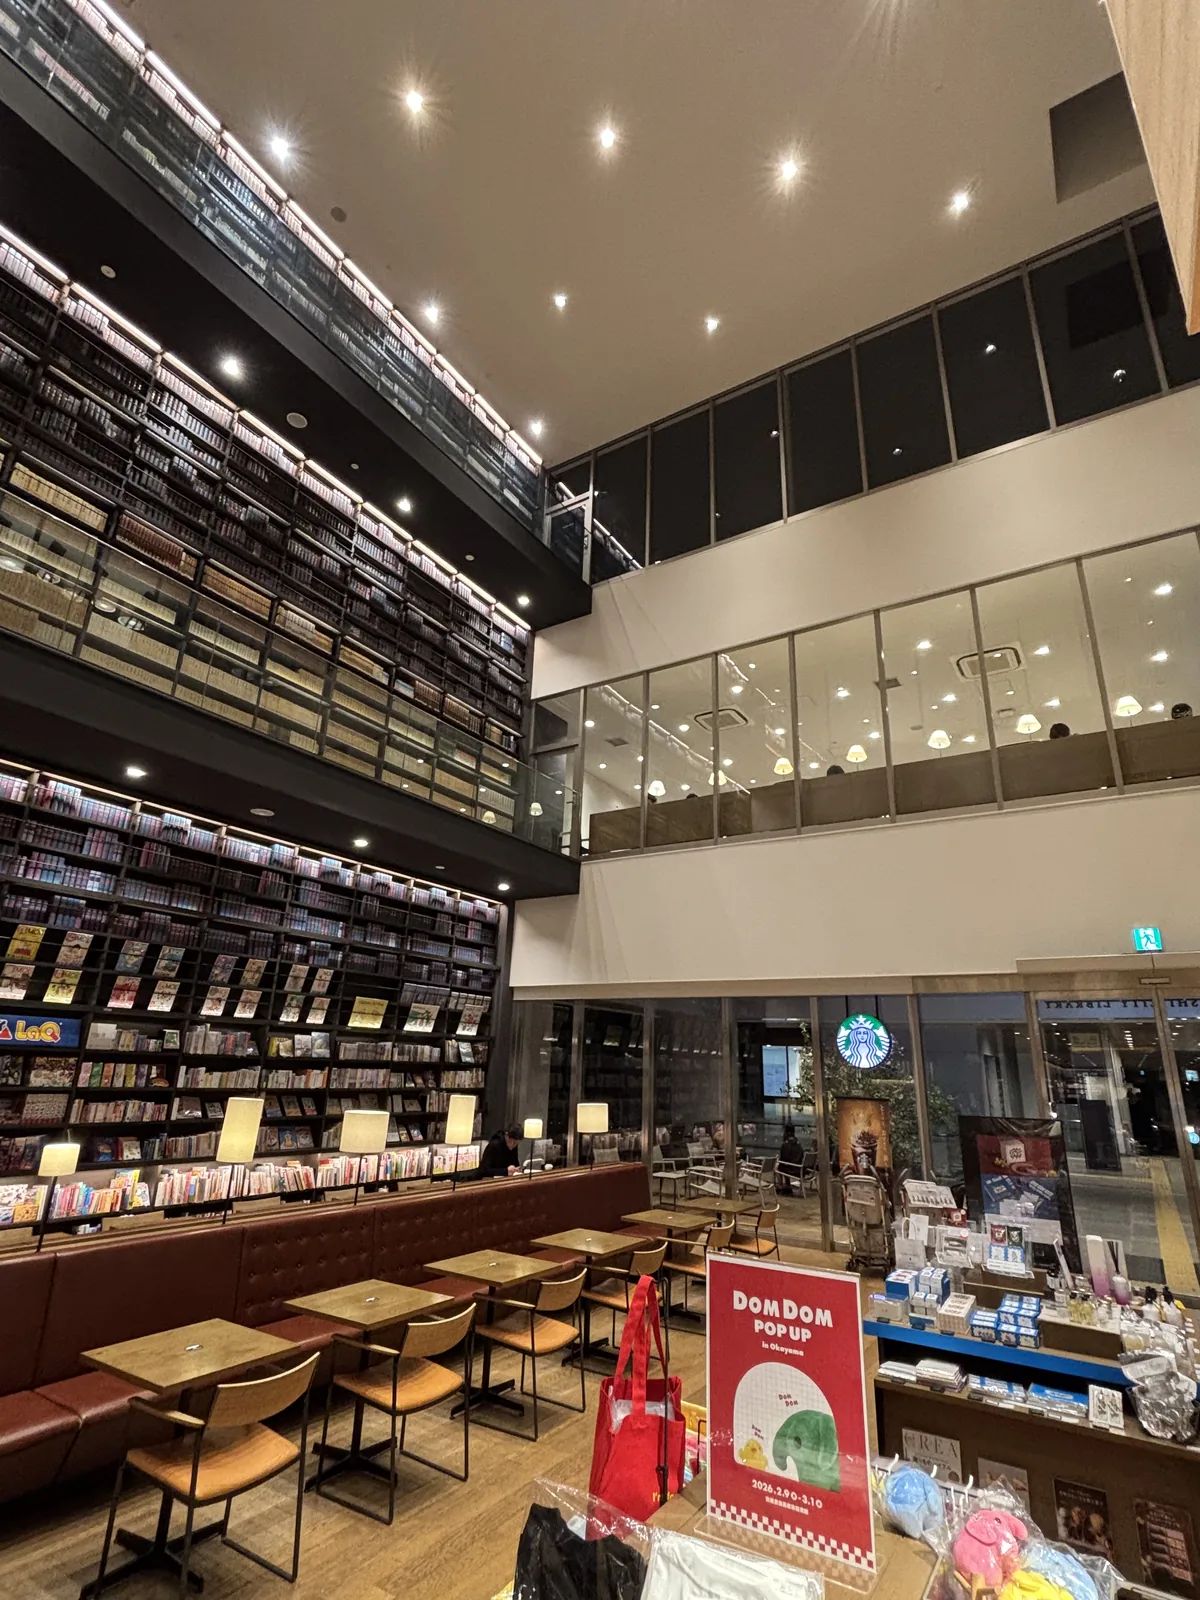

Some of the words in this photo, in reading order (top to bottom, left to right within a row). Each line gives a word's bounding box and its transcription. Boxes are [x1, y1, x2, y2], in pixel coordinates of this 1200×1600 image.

[14, 1020, 61, 1043] LaQ
[754, 1319, 787, 1338] POP
[789, 1325, 812, 1343] UP
[770, 1343, 804, 1357] Okayama
